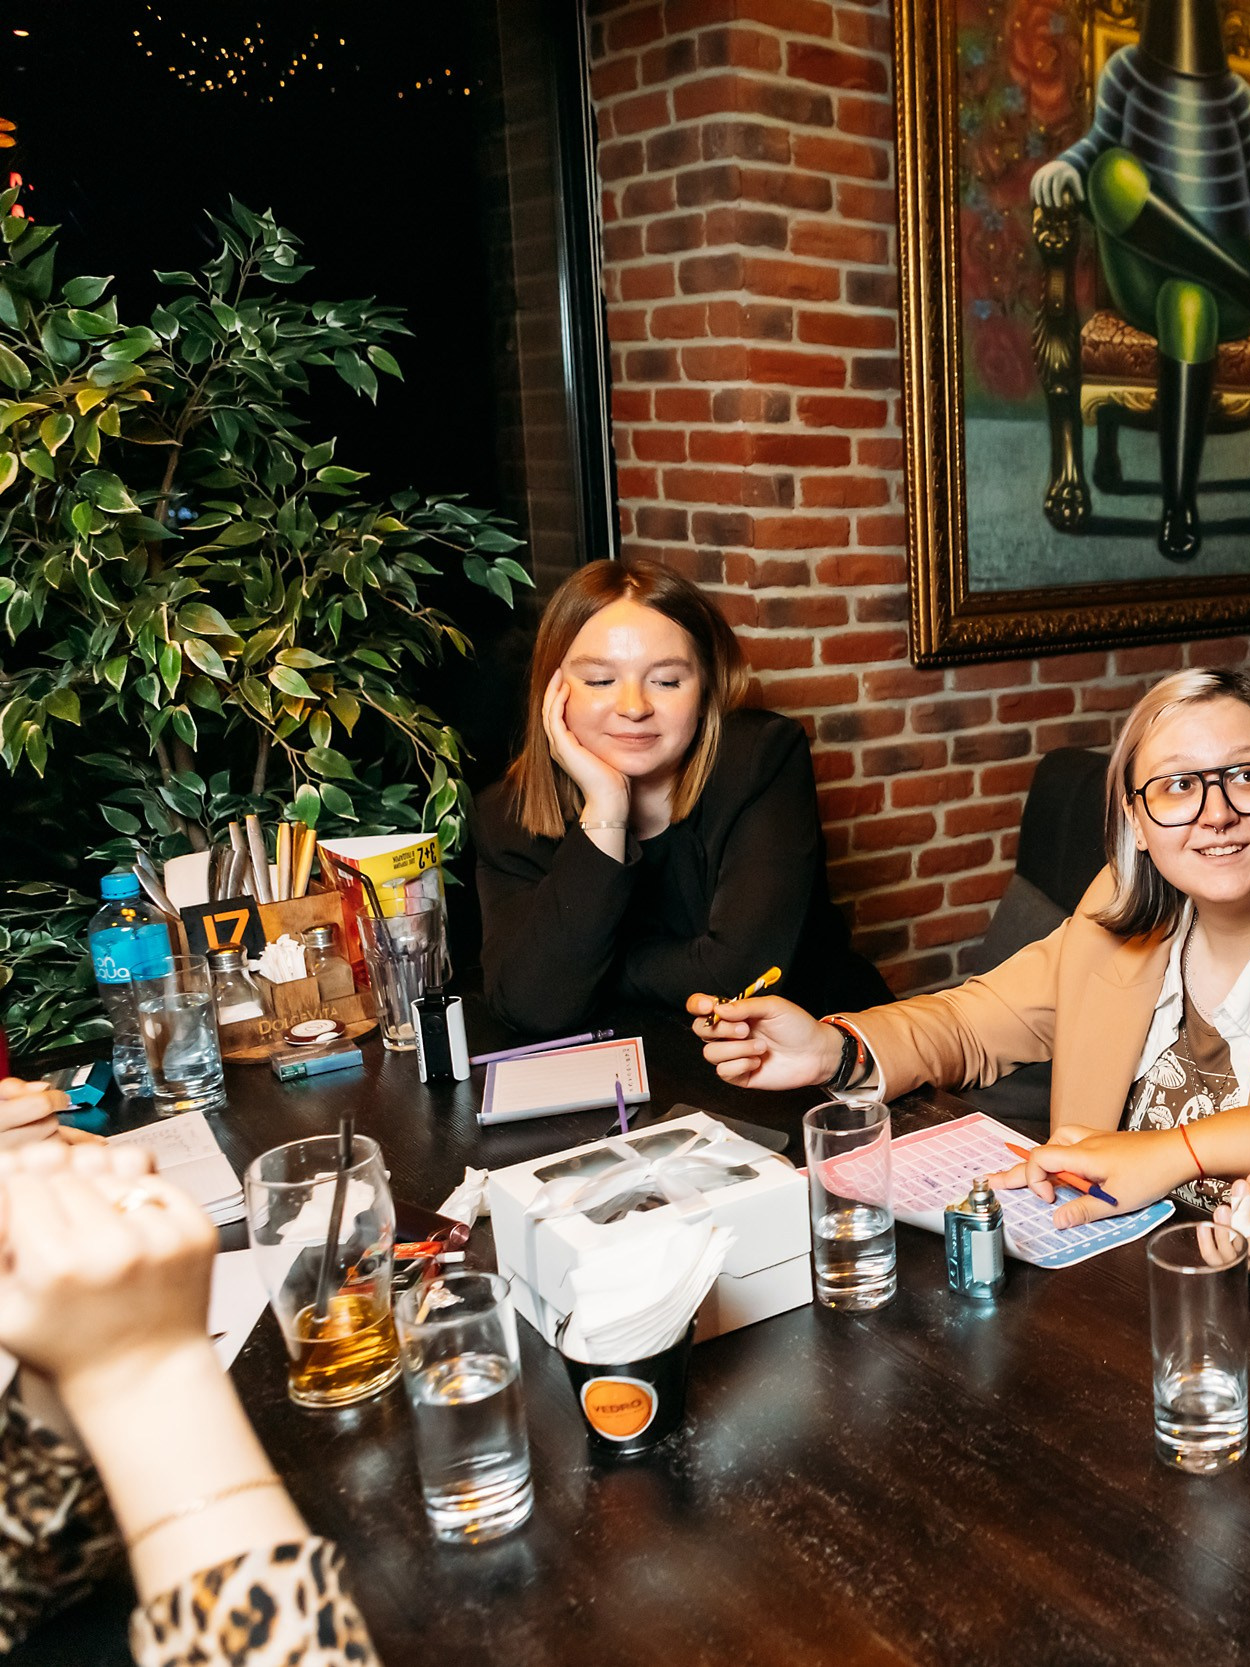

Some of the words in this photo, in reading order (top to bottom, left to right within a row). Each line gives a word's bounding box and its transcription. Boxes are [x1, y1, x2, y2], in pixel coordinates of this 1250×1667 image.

[417, 842, 437, 869] 3+2
[203, 908, 249, 949] 17
[97, 957, 116, 968] on
[97, 968, 130, 980] qua
